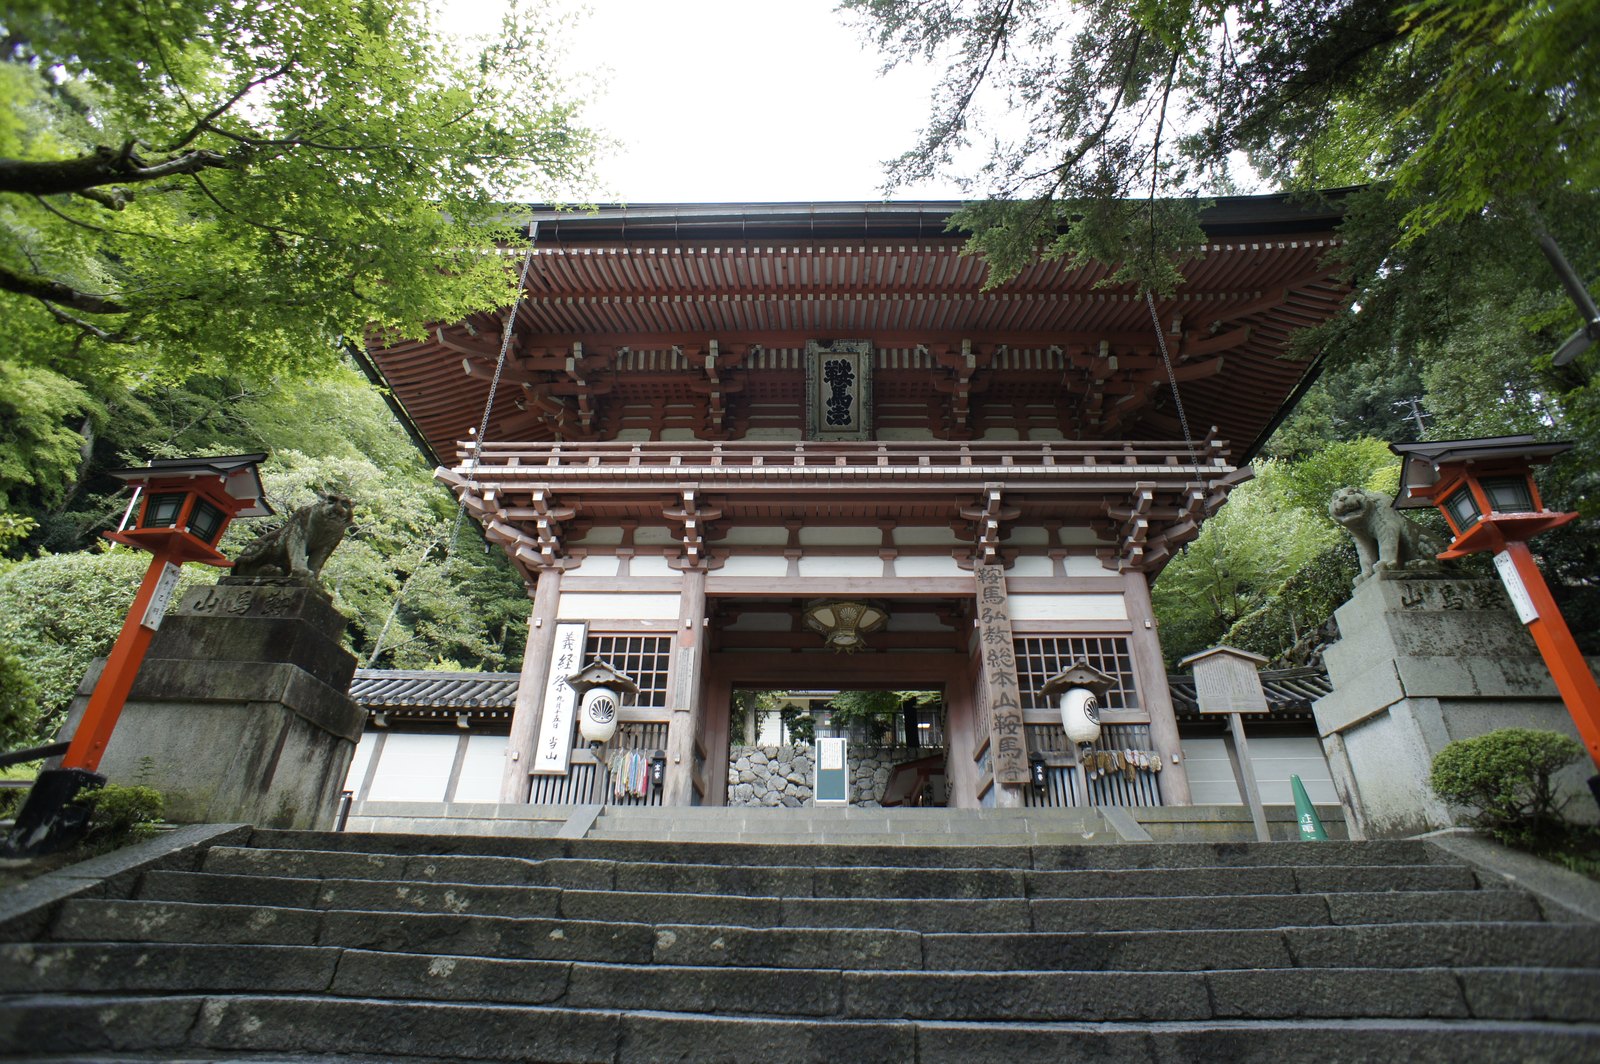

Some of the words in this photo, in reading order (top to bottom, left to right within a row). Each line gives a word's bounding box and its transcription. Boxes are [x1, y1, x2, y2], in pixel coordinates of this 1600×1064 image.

[552, 631, 575, 692] 義経祭
[977, 567, 1028, 782] 鞍馬弘教総本山鞍馬寺
[545, 736, 558, 760] 当山
